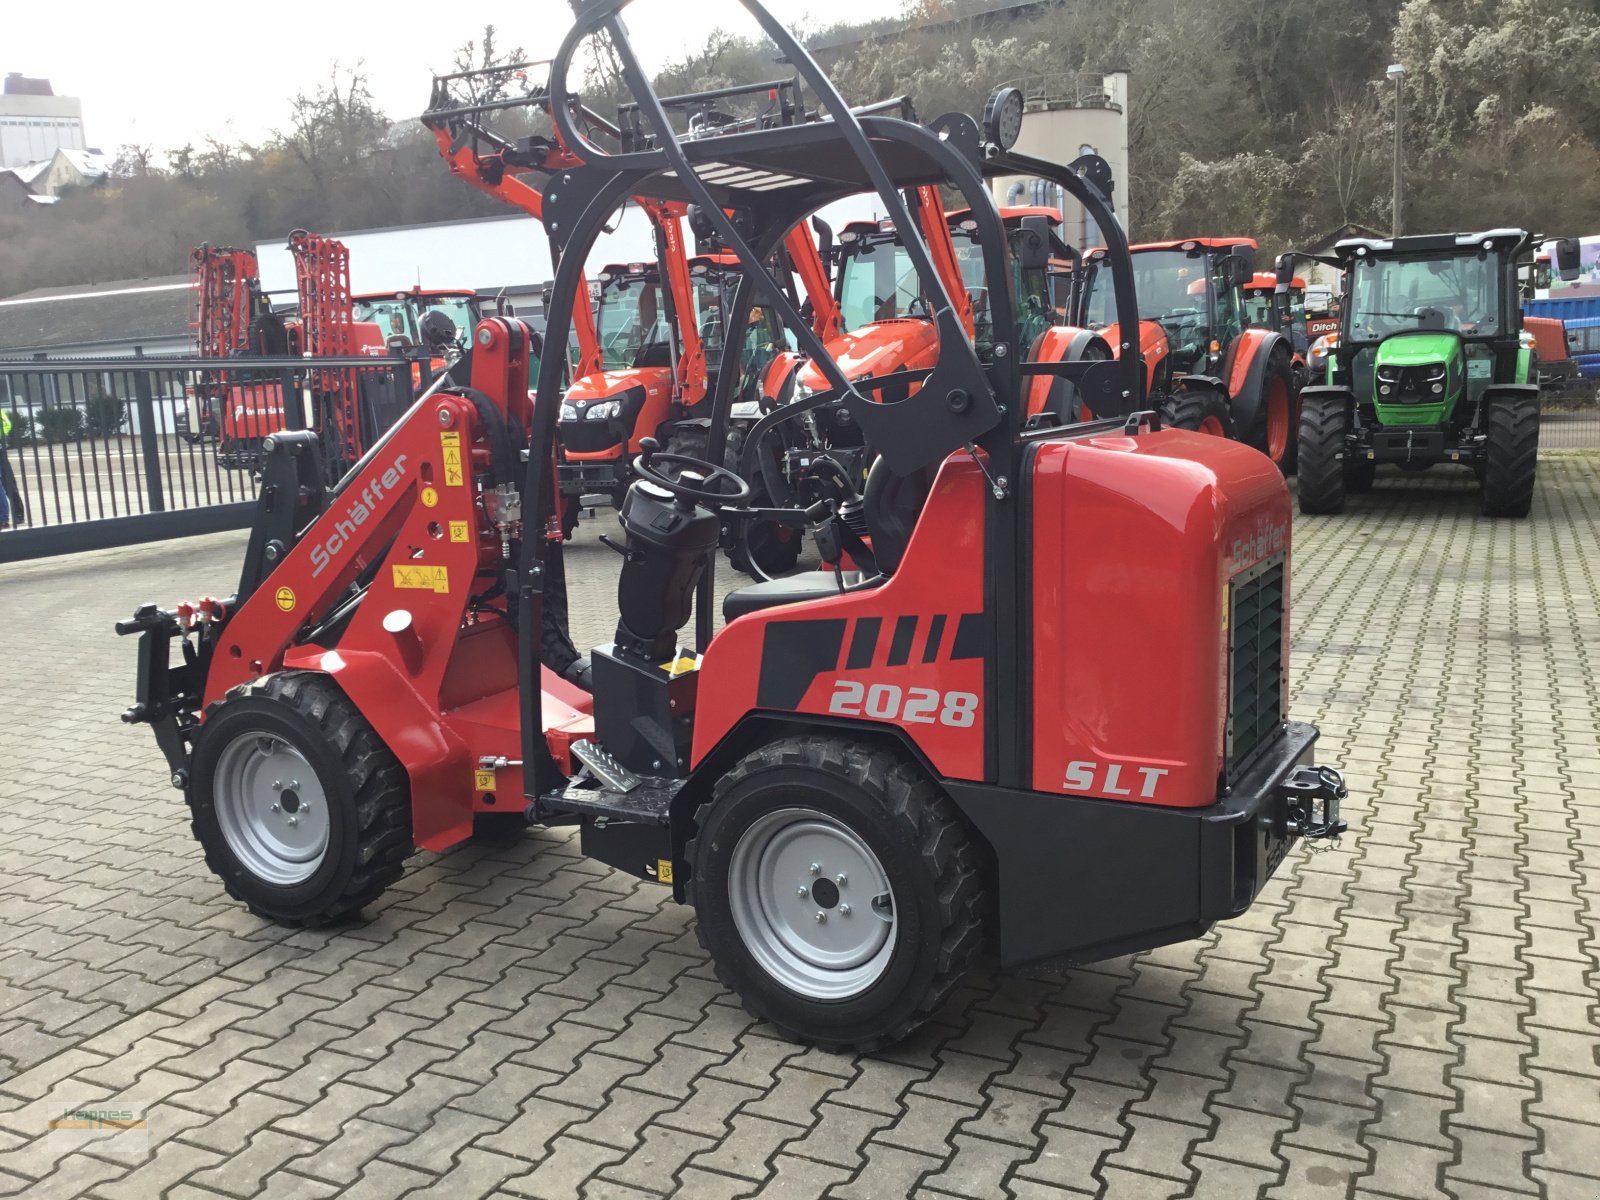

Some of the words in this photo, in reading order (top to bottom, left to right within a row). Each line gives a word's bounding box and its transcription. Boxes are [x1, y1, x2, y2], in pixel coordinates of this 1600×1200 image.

[1312, 322, 1337, 332] Ditch
[310, 454, 407, 578] Schäffer
[1229, 519, 1286, 572] Schäffer
[828, 679, 979, 728] 2028
[1062, 760, 1169, 798] SLT
